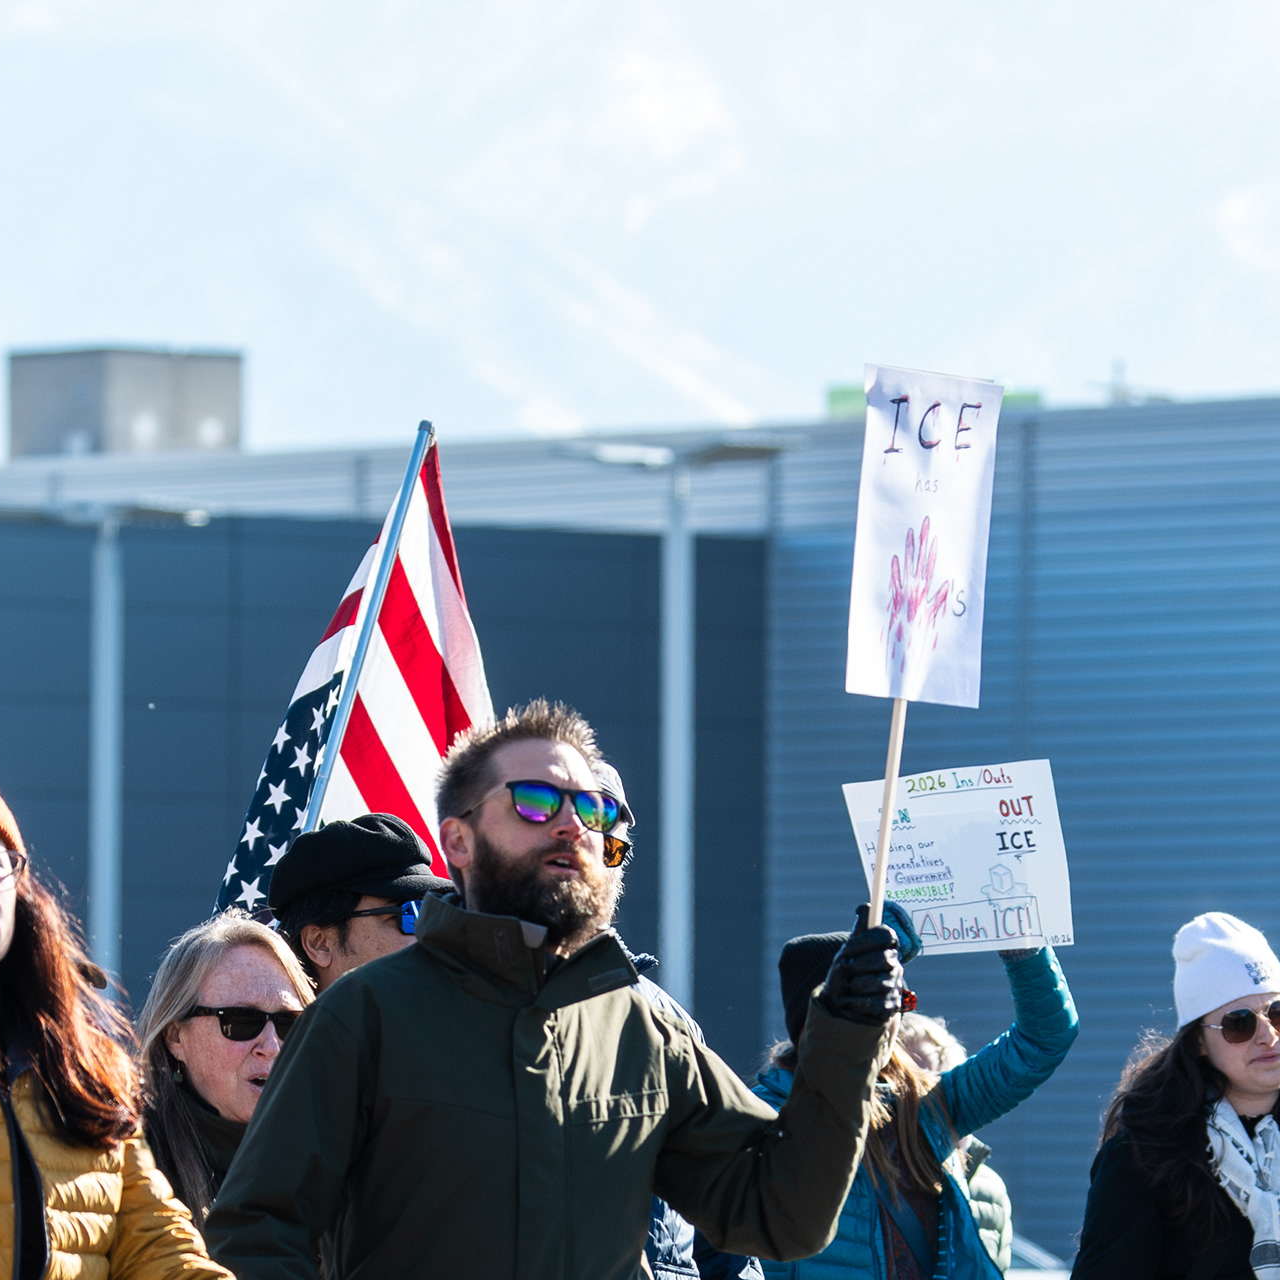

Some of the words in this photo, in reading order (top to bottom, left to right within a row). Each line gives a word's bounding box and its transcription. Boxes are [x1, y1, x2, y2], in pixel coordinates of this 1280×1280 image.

[883, 395, 983, 454] ICE
[914, 470, 939, 493] has
[905, 774, 947, 794] 2026
[999, 795, 1034, 818] OUT
[865, 841, 916, 861] Hding
[996, 830, 1036, 851] ICE
[895, 865, 953, 885] Government
[919, 910, 989, 941] Abolish
